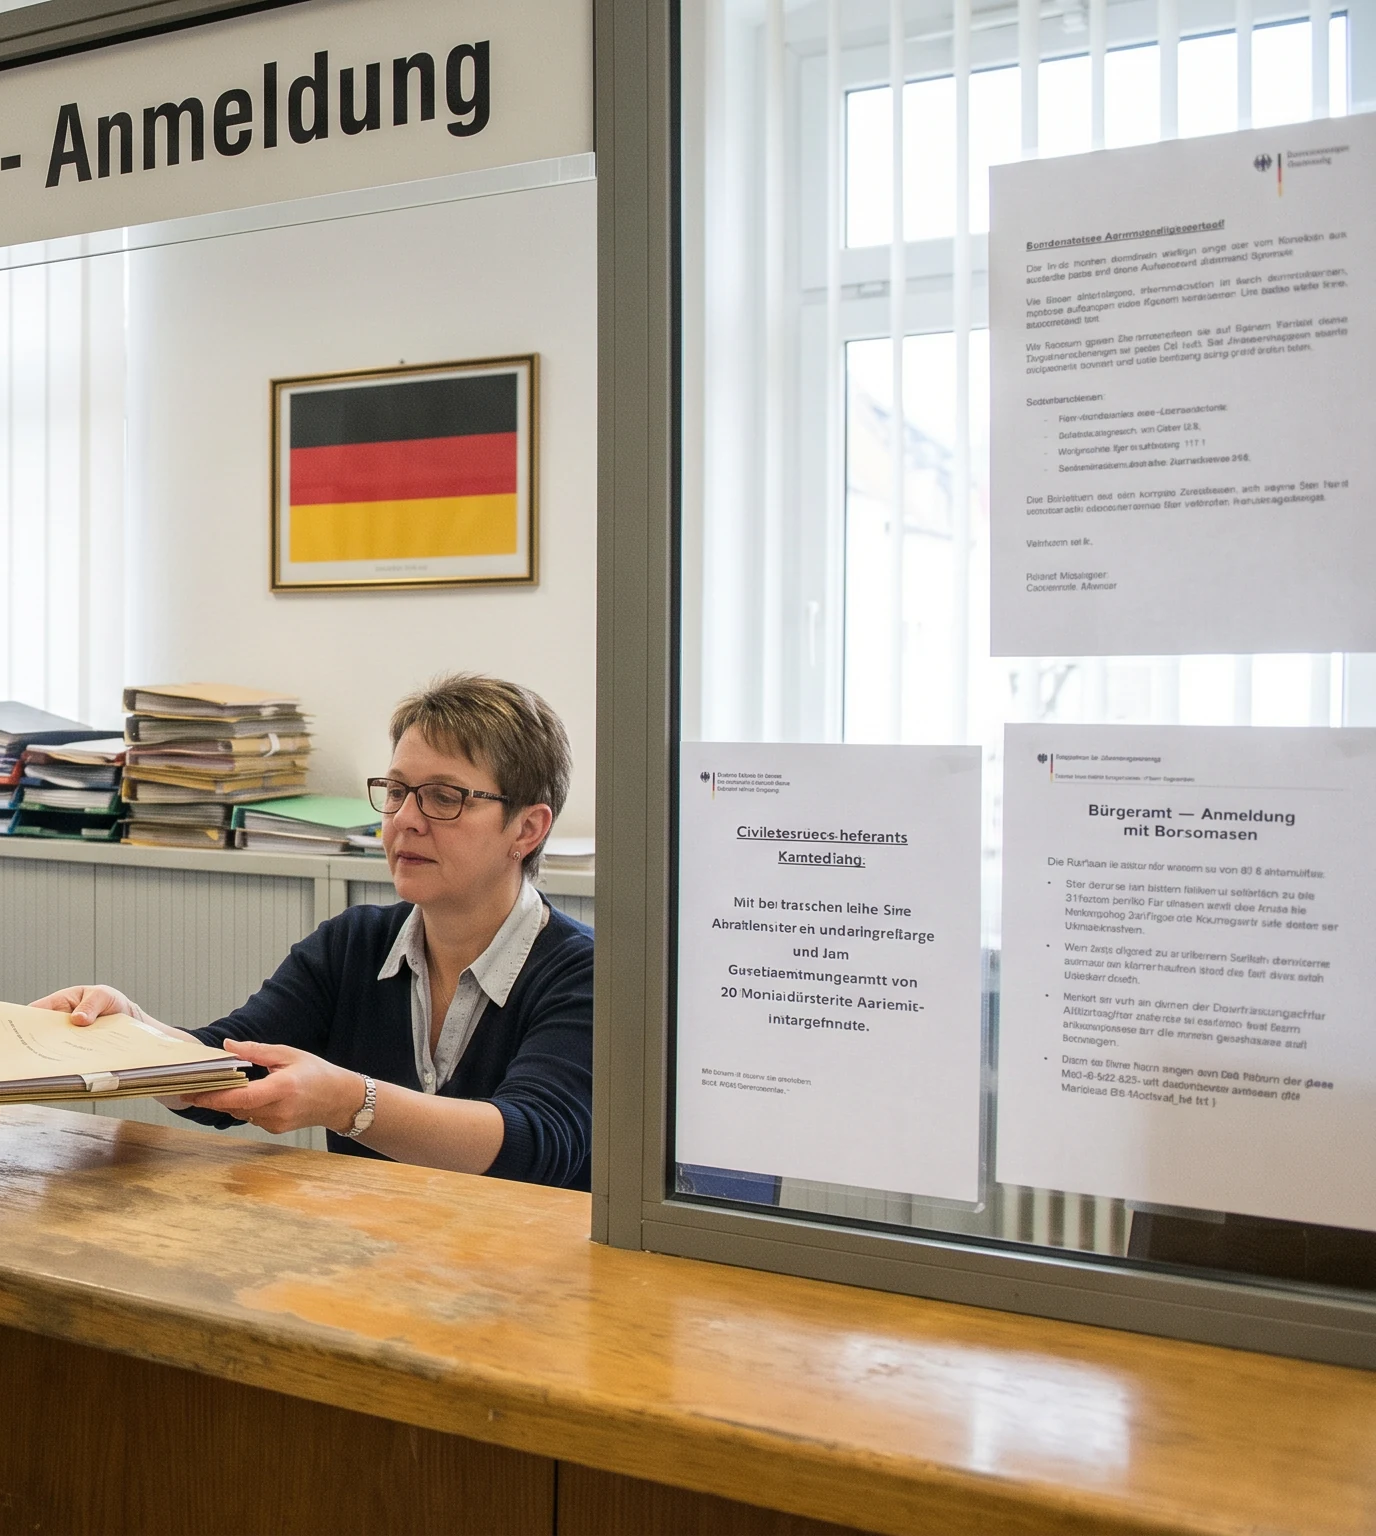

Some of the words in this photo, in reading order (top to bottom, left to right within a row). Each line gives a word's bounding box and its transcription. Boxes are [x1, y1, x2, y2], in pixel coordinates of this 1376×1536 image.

[0, 154, 22, 171] -
[45, 38, 492, 189] Anmeldung
[1088, 803, 1172, 820] Bürgeramt
[1201, 807, 1296, 826] Anmeldung
[1124, 824, 1150, 837] mit
[1155, 825, 1258, 841] Borsomasen
[1048, 857, 1064, 866] Die
[734, 897, 754, 907] Mit
[847, 903, 878, 915] leihe
[793, 947, 818, 957] und
[823, 948, 848, 959] Jam
[892, 979, 917, 988] von
[721, 987, 737, 997] 20
[1192, 1003, 1210, 1011] der
